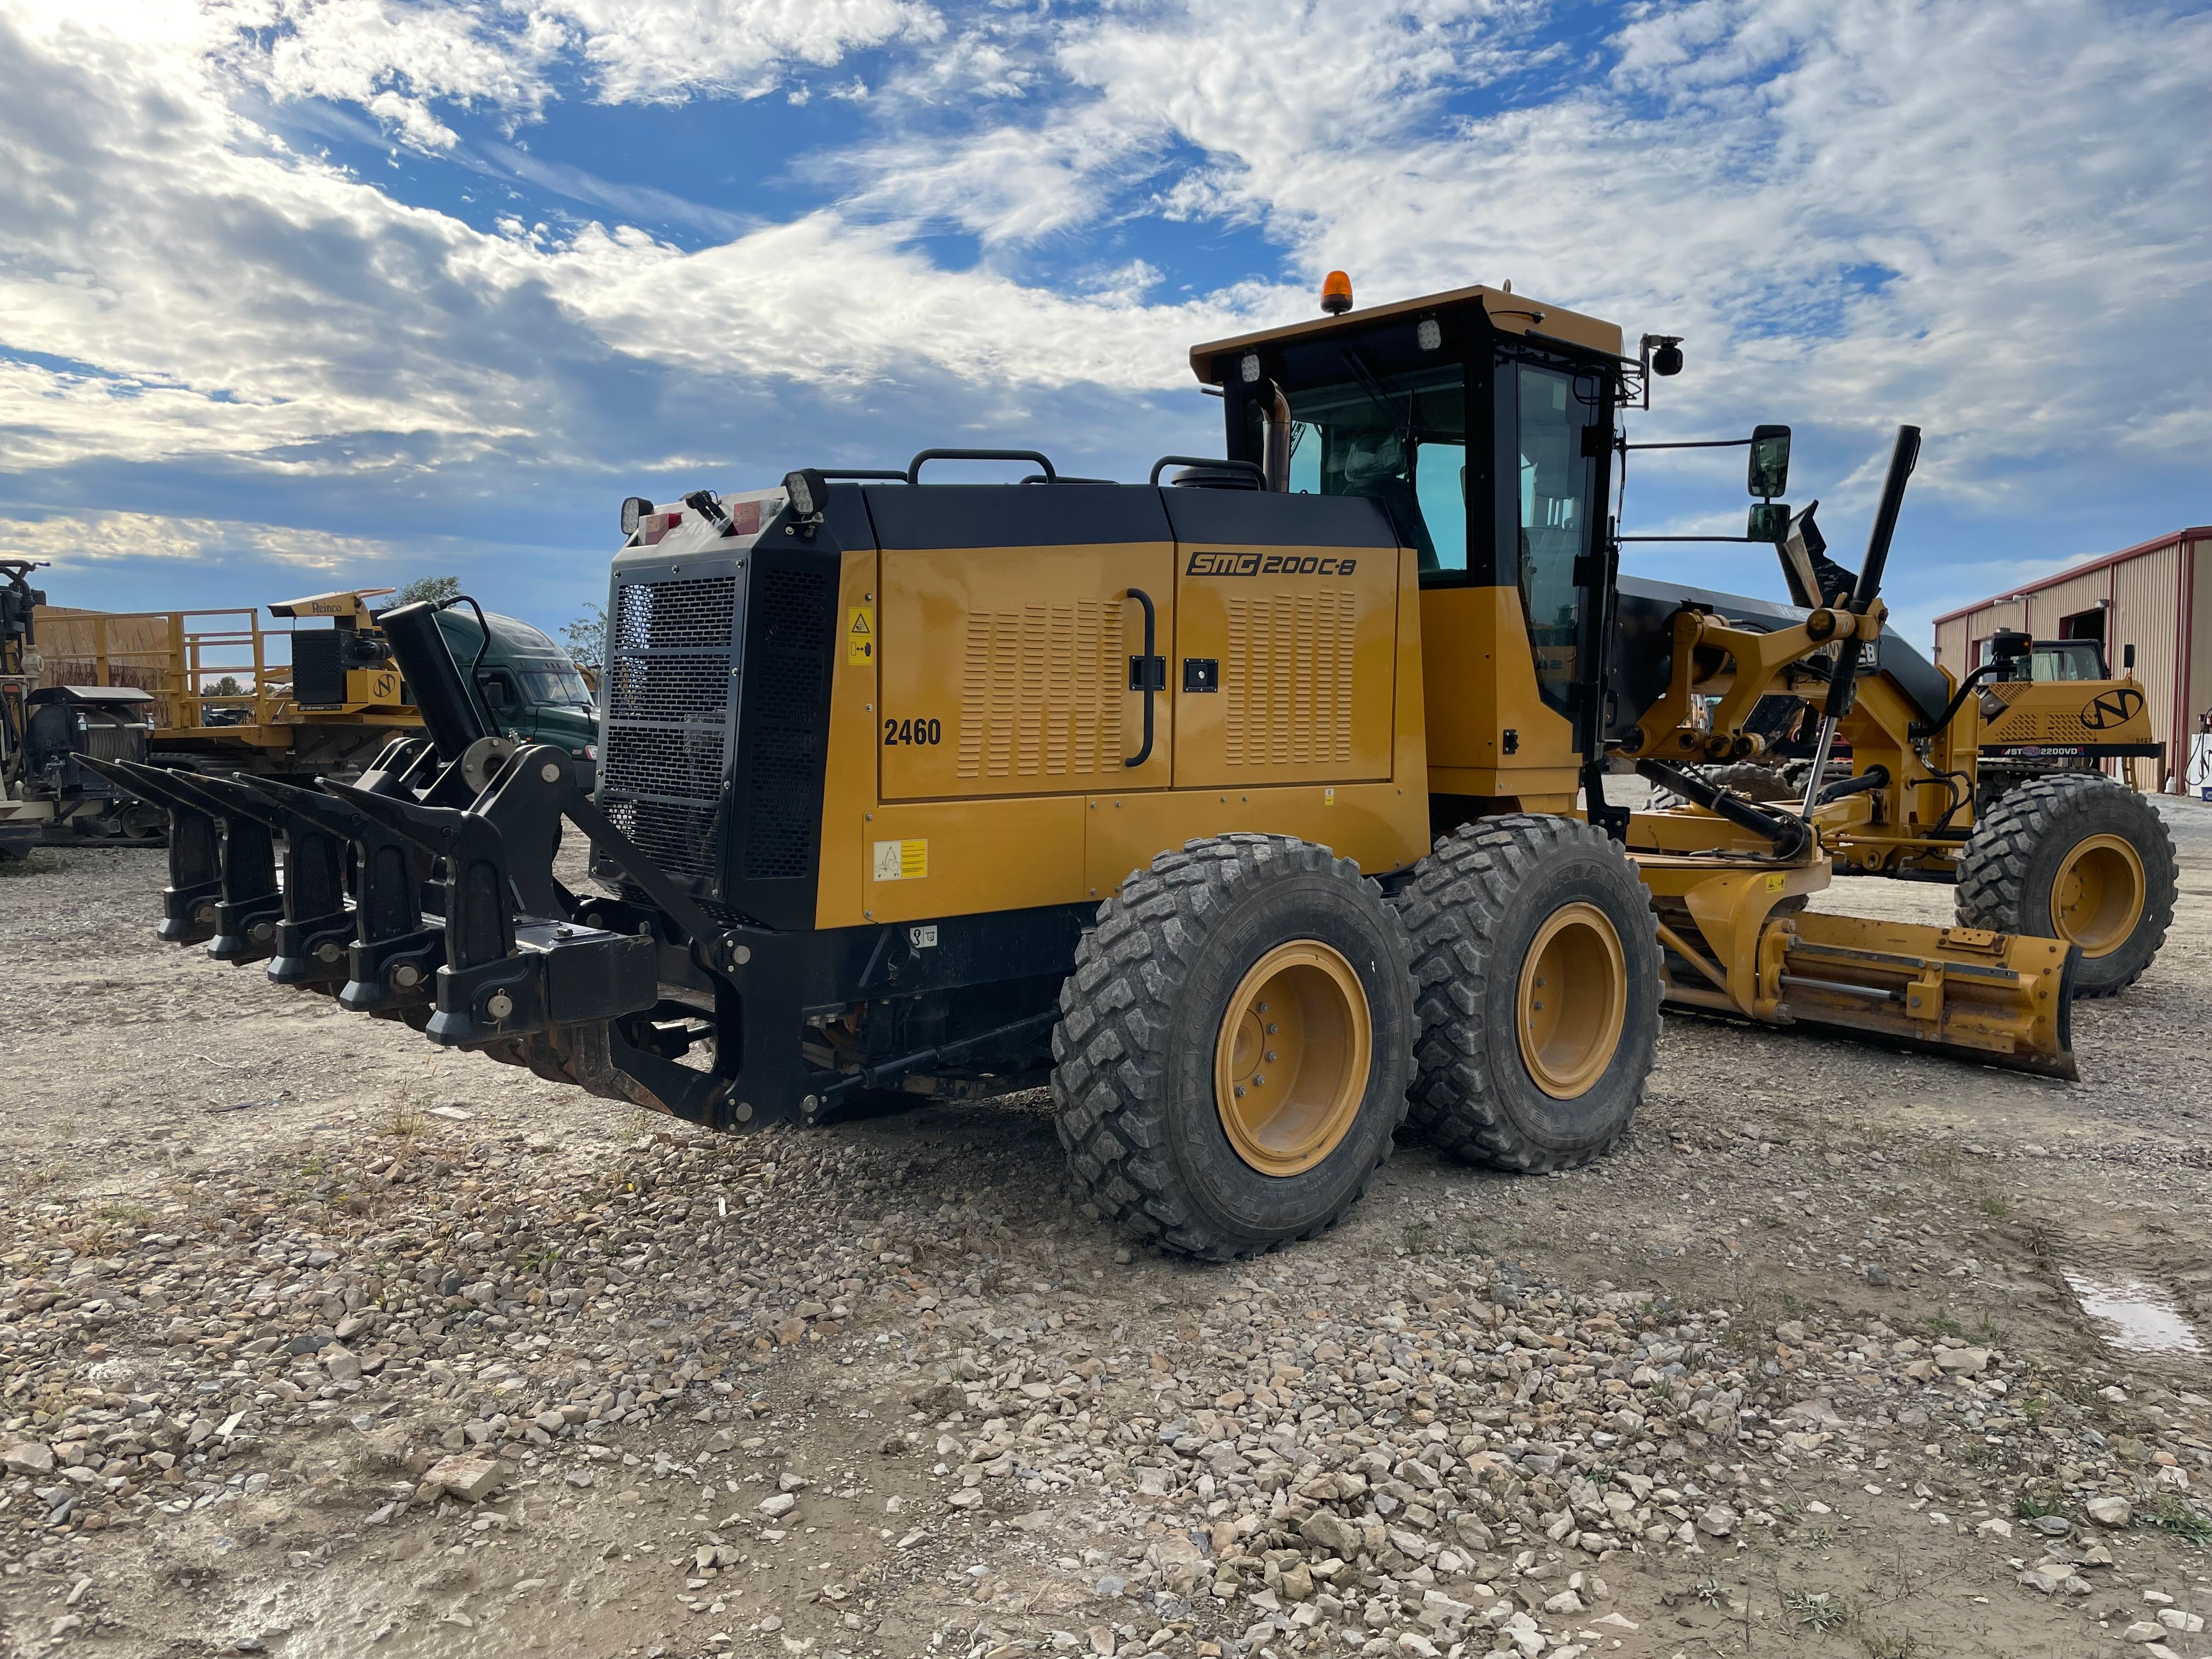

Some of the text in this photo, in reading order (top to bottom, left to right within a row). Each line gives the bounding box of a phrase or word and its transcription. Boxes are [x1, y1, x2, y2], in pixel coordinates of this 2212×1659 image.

[1190, 554, 1357, 575] SMG 200C-8
[312, 602, 342, 613] Reinco
[884, 718, 940, 745] 2460
[1182, 917, 1261, 1222] TRIANGLE
